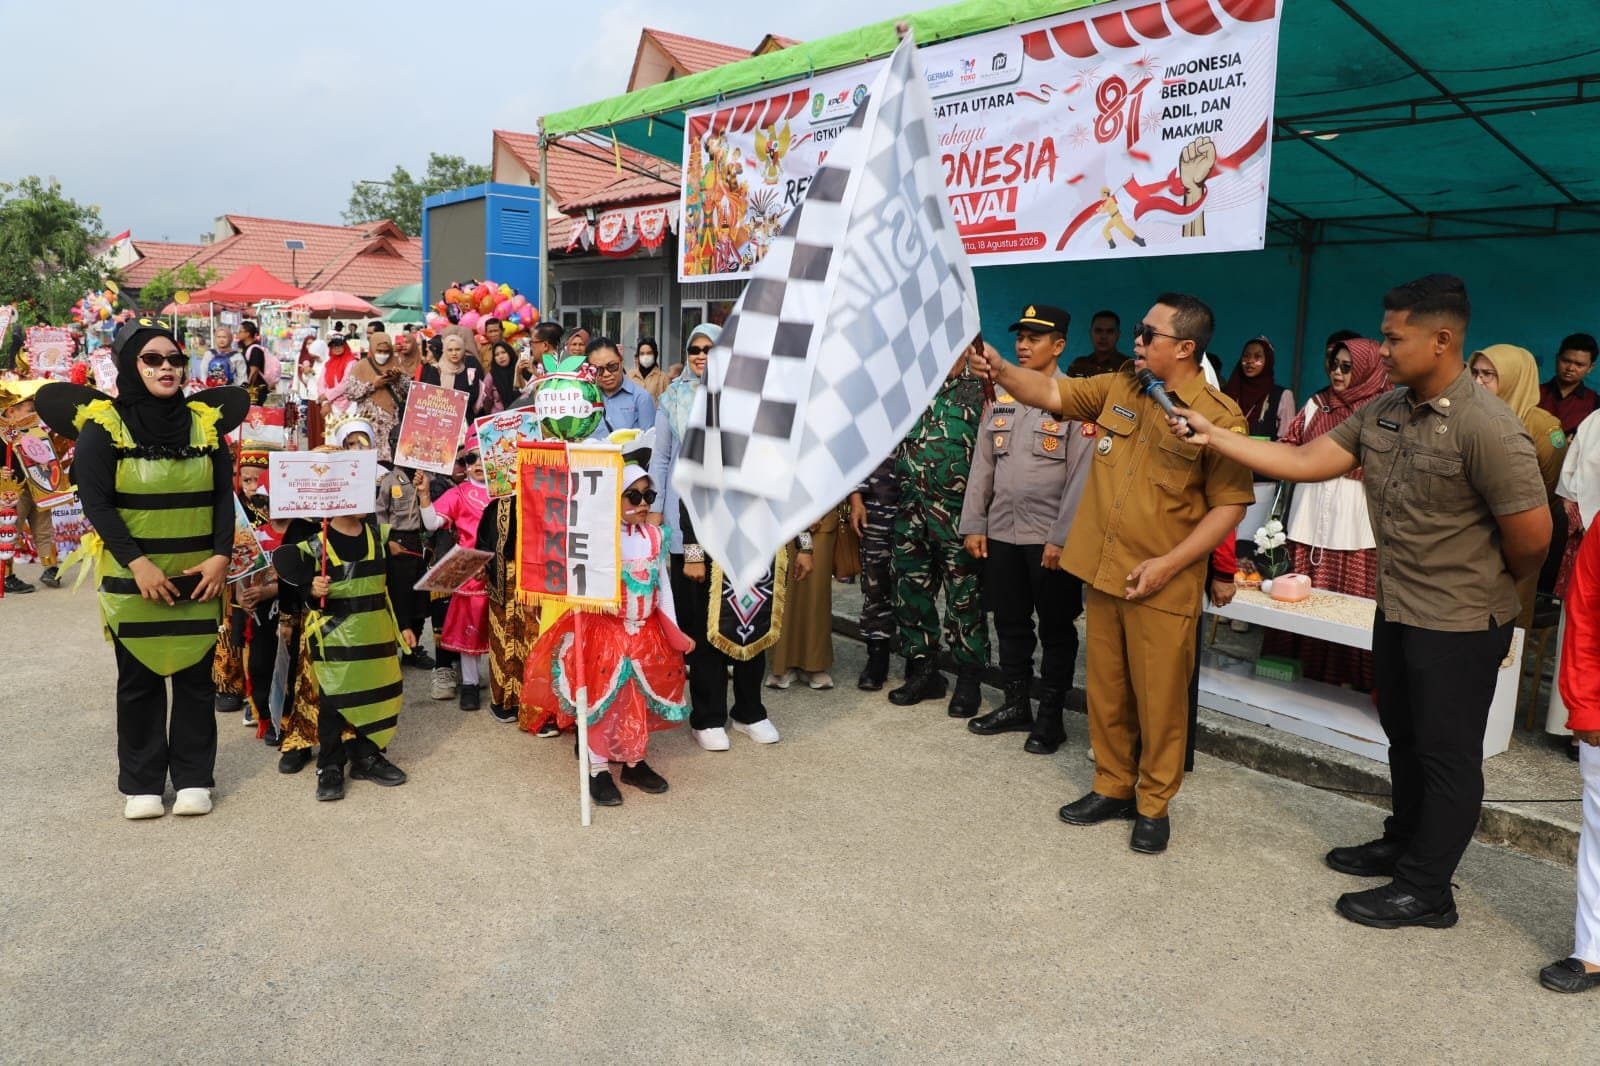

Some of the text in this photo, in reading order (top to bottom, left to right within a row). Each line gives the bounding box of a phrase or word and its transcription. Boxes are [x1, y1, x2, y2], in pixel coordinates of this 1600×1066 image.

[927, 70, 954, 82] GERMAS
[1164, 52, 1242, 79] INDONESIA
[1161, 73, 1247, 99] BERDAULAT,
[971, 92, 1015, 112] UTARA
[1094, 74, 1154, 150] 81
[1161, 96, 1231, 120] ADIL, DAN
[813, 127, 837, 143] IGTKI
[938, 122, 986, 153] ahayu
[1162, 119, 1223, 141] MAKMUR
[978, 240, 986, 249] 18
[987, 238, 1018, 251] Agustus
[1019, 237, 1040, 246] 2026
[544, 391, 580, 401] TULIP
[533, 466, 603, 496] HUT
[545, 497, 578, 527] RI
[544, 531, 589, 561] KE
[545, 560, 586, 596] 81
